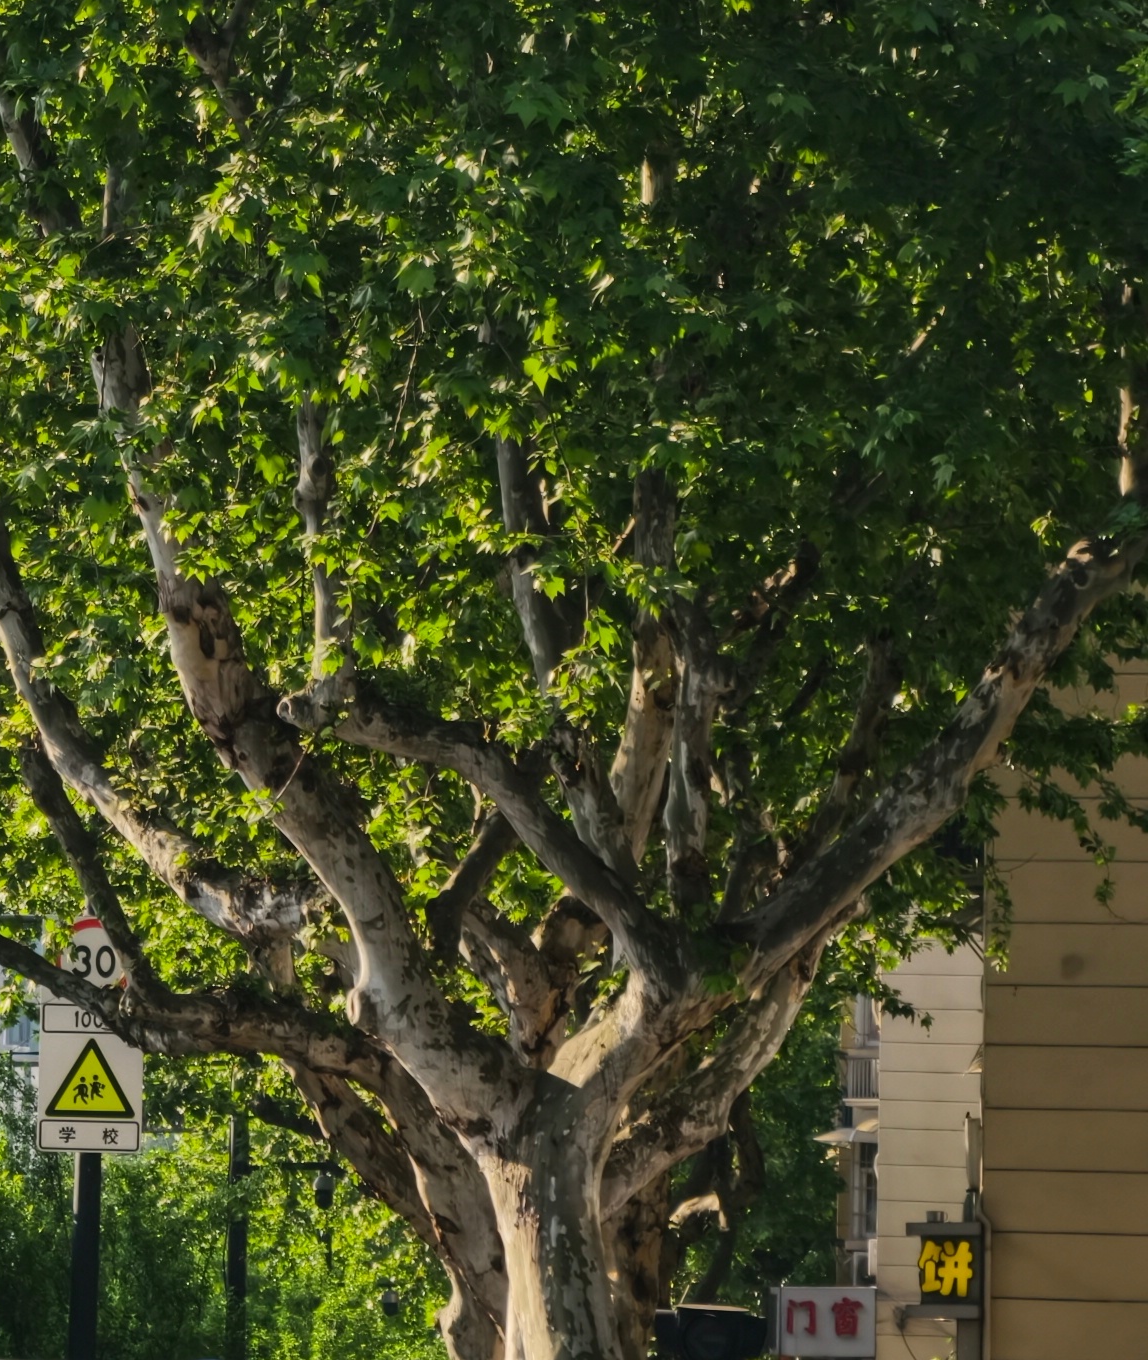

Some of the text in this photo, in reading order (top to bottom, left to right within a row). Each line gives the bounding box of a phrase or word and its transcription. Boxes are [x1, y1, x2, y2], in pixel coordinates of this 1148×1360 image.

[71, 945, 117, 979] 30
[58, 1126, 120, 1146] 学校
[918, 1240, 973, 1298] 饼
